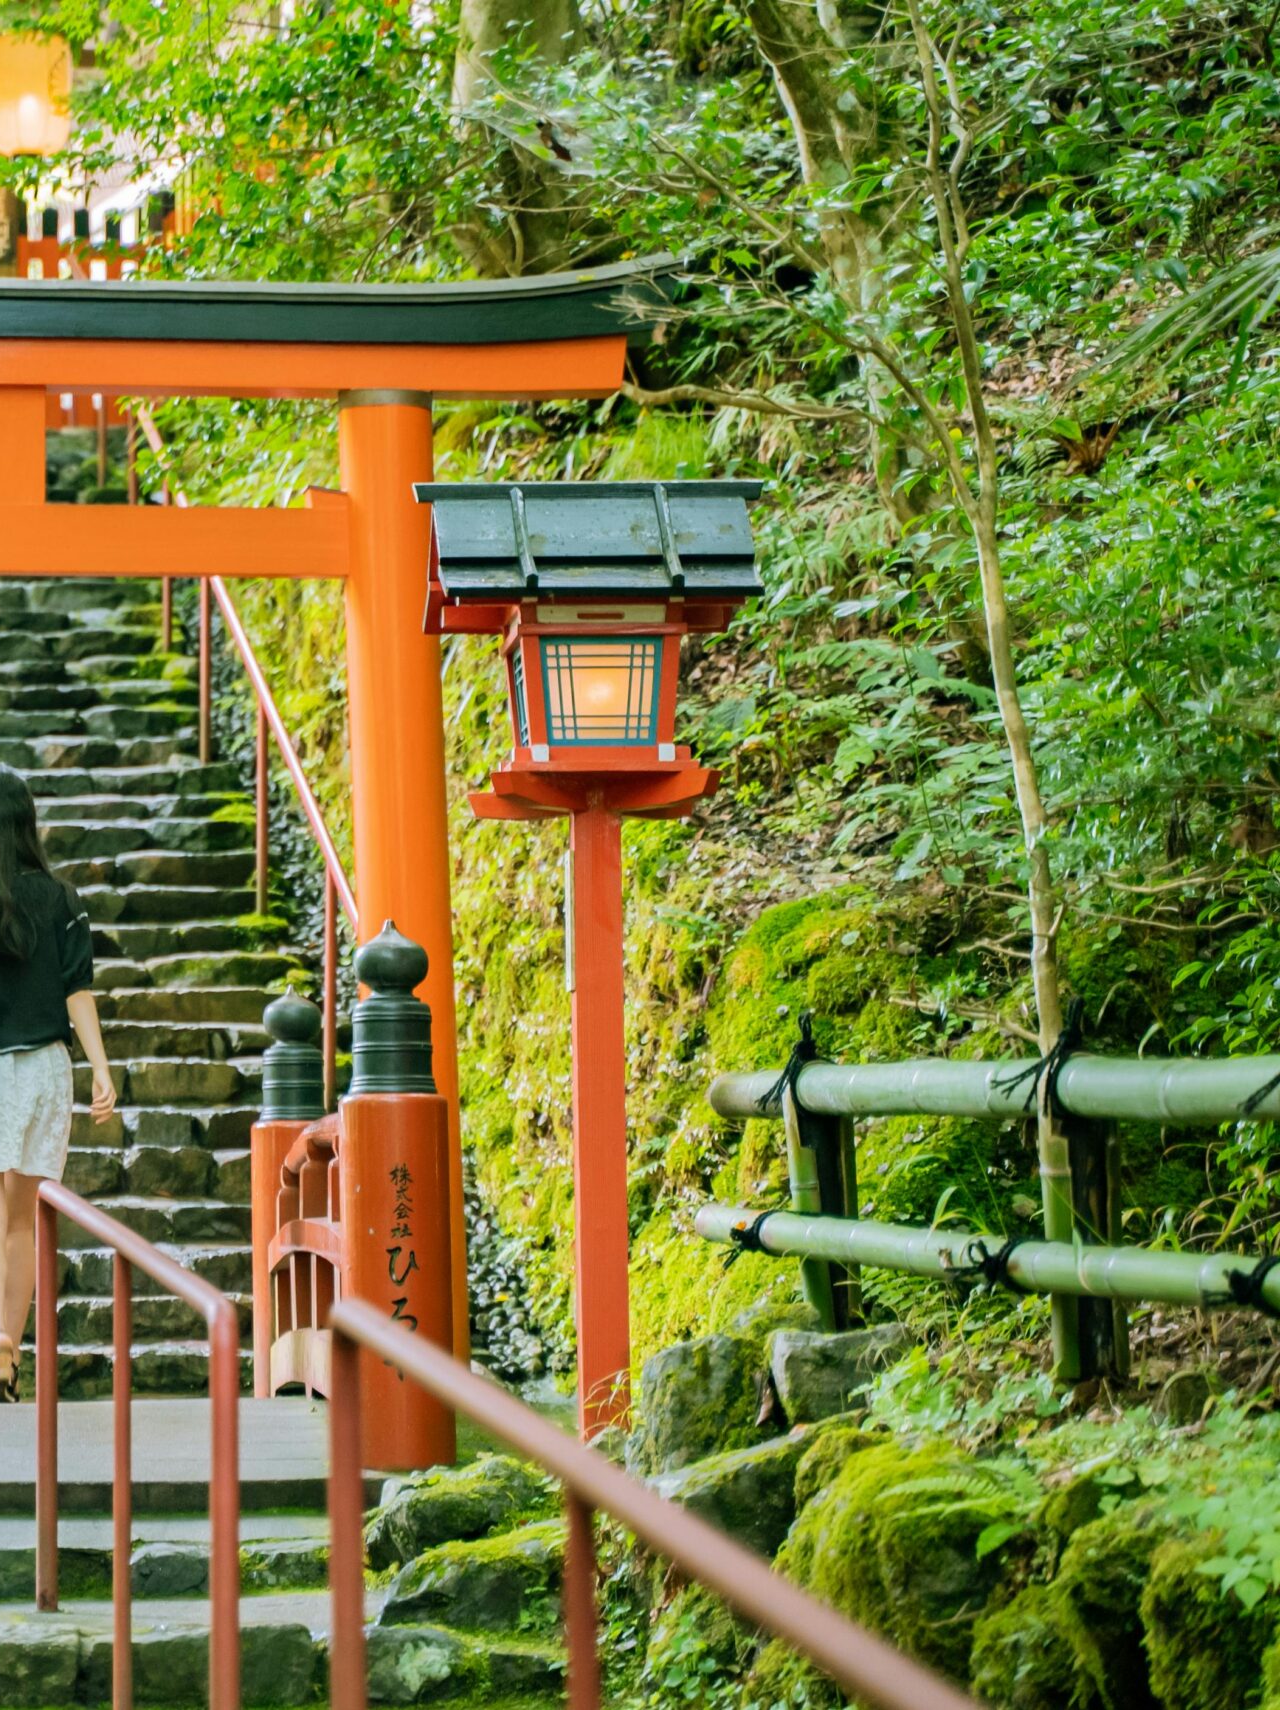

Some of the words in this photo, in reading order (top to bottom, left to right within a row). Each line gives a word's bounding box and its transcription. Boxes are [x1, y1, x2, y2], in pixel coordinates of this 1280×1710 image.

[384, 1162, 420, 1382] 株式会社ひろ
